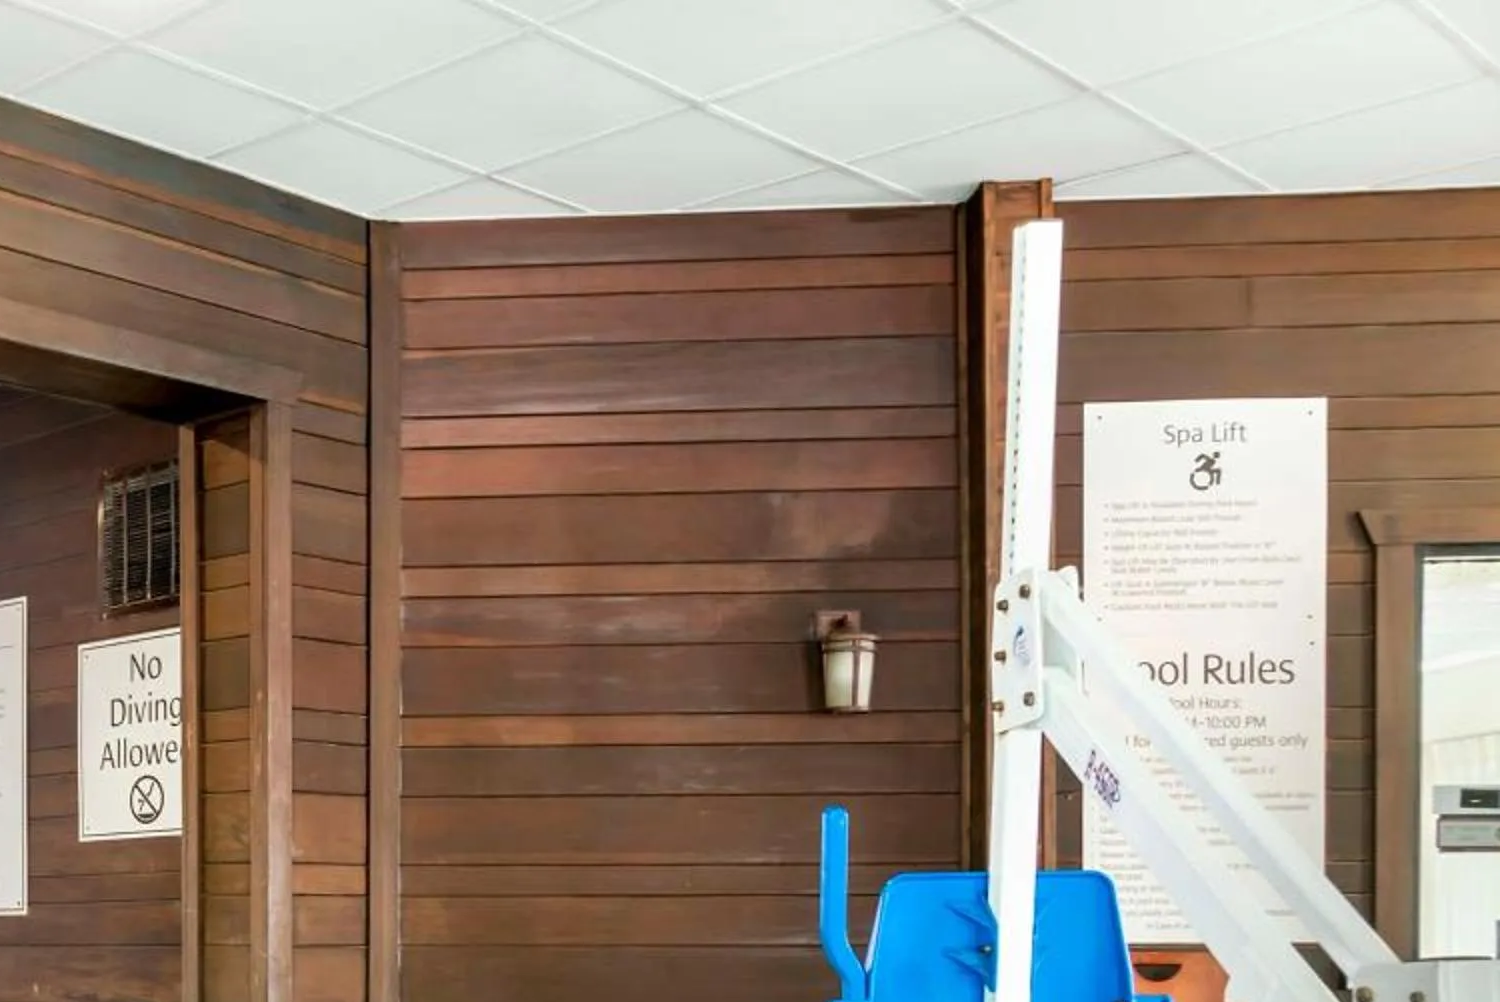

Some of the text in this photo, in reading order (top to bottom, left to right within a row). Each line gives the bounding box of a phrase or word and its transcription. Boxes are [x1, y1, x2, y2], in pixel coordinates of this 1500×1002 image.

[1163, 421, 1248, 448] Spa Lift
[130, 651, 162, 682] No
[1139, 652, 1296, 685] ool Rules
[111, 691, 181, 728] Diving
[1169, 696, 1195, 709] ool
[1245, 716, 1266, 729] PM
[100, 738, 181, 770] Allowe
[1229, 736, 1275, 750] guests
[1278, 733, 1309, 749] only
